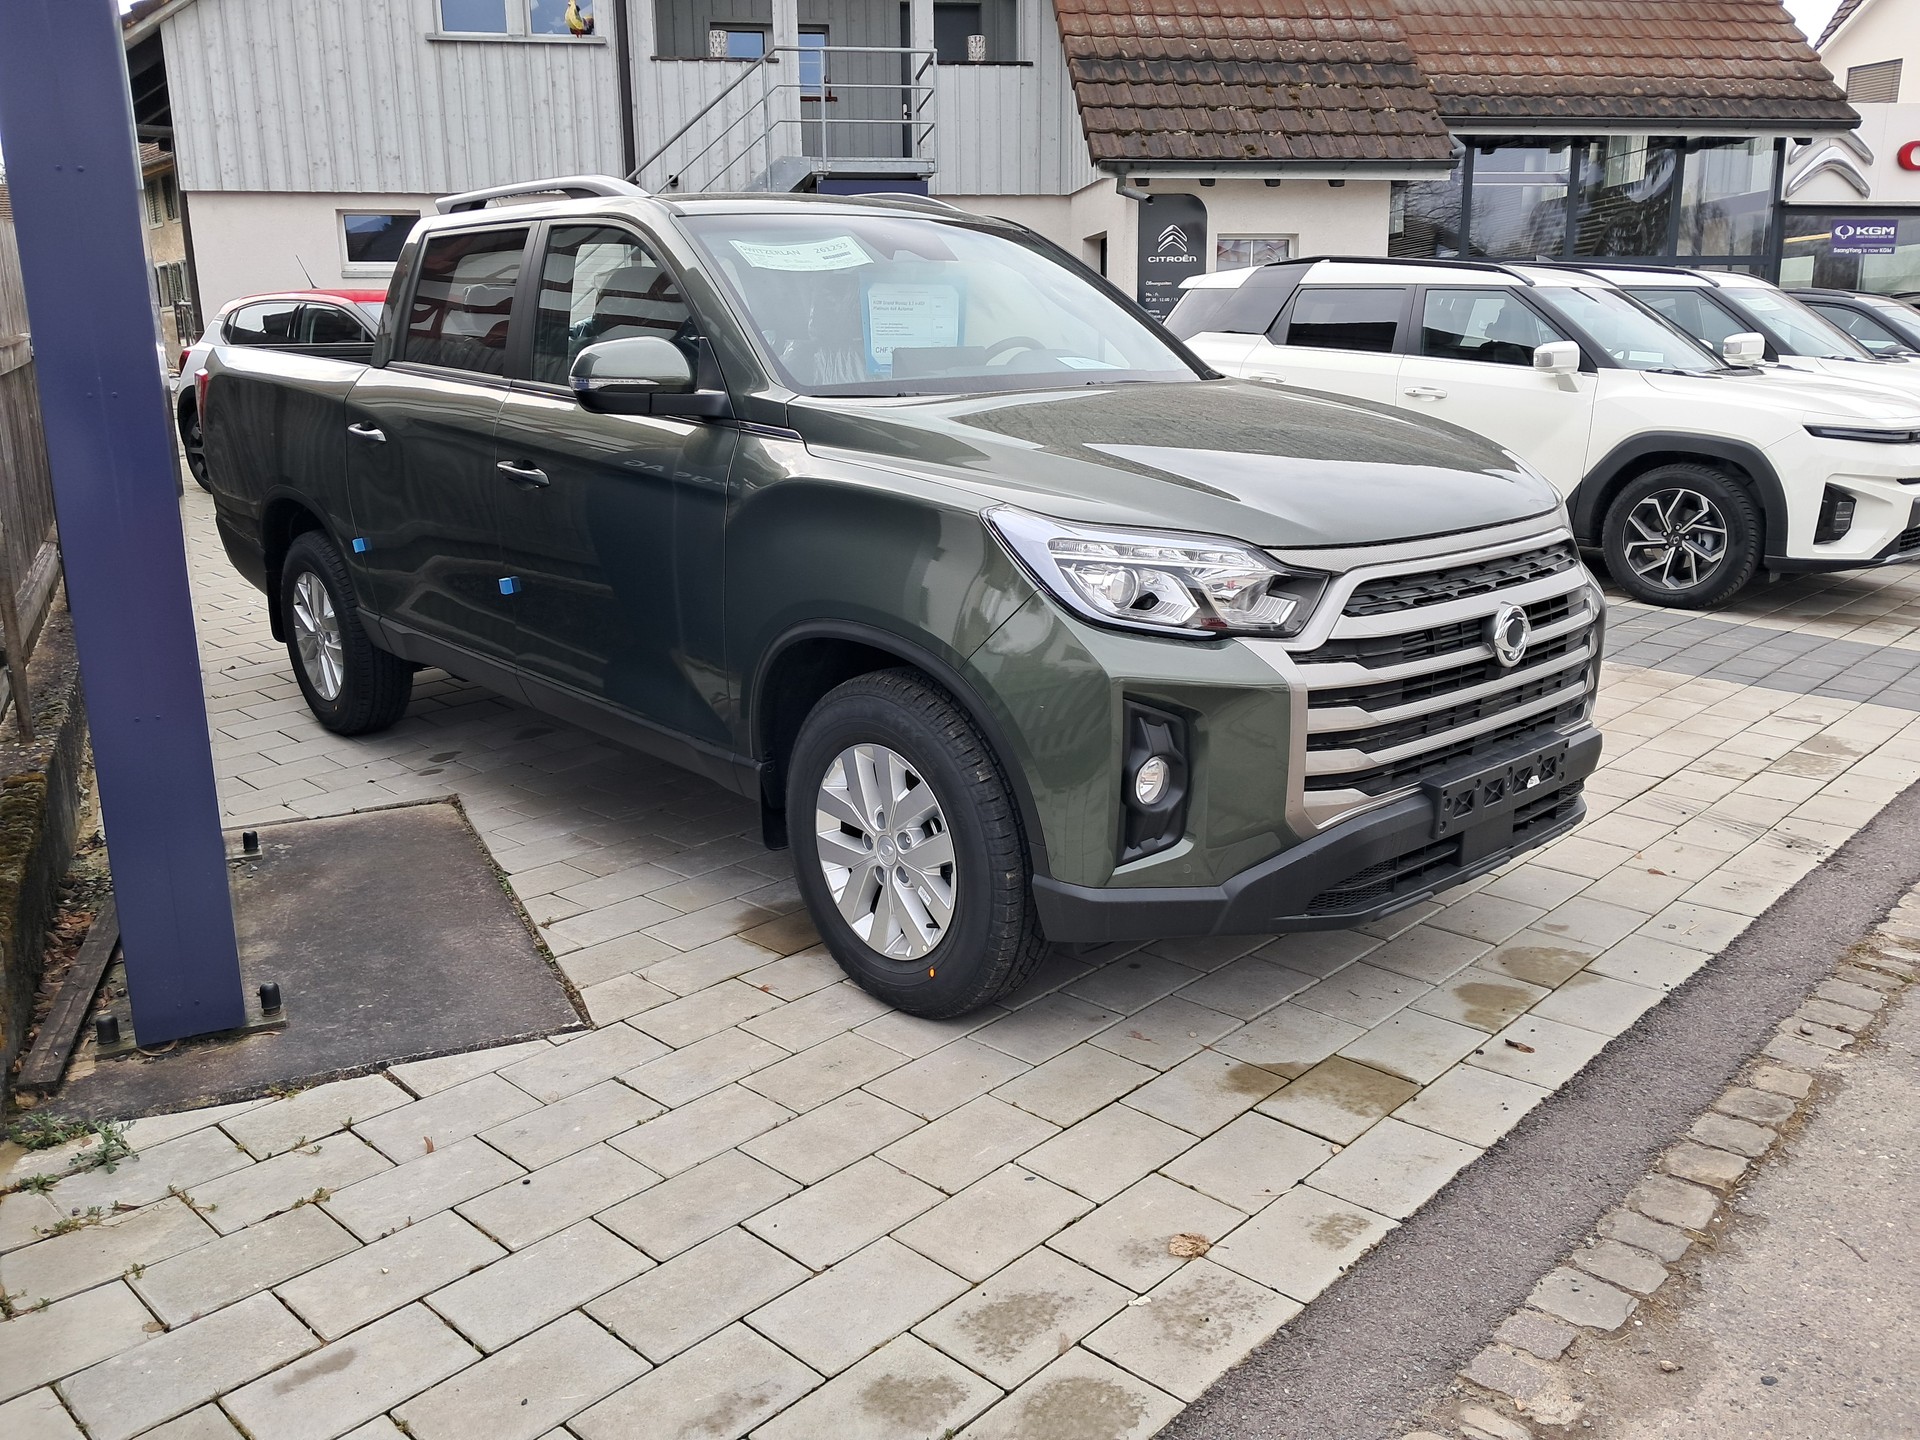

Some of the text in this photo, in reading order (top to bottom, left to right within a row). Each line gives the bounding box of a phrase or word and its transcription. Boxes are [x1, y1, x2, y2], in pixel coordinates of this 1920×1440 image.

[1856, 226, 1895, 235] KGM
[813, 242, 849, 254] 261253
[875, 346, 889, 354] CHF
